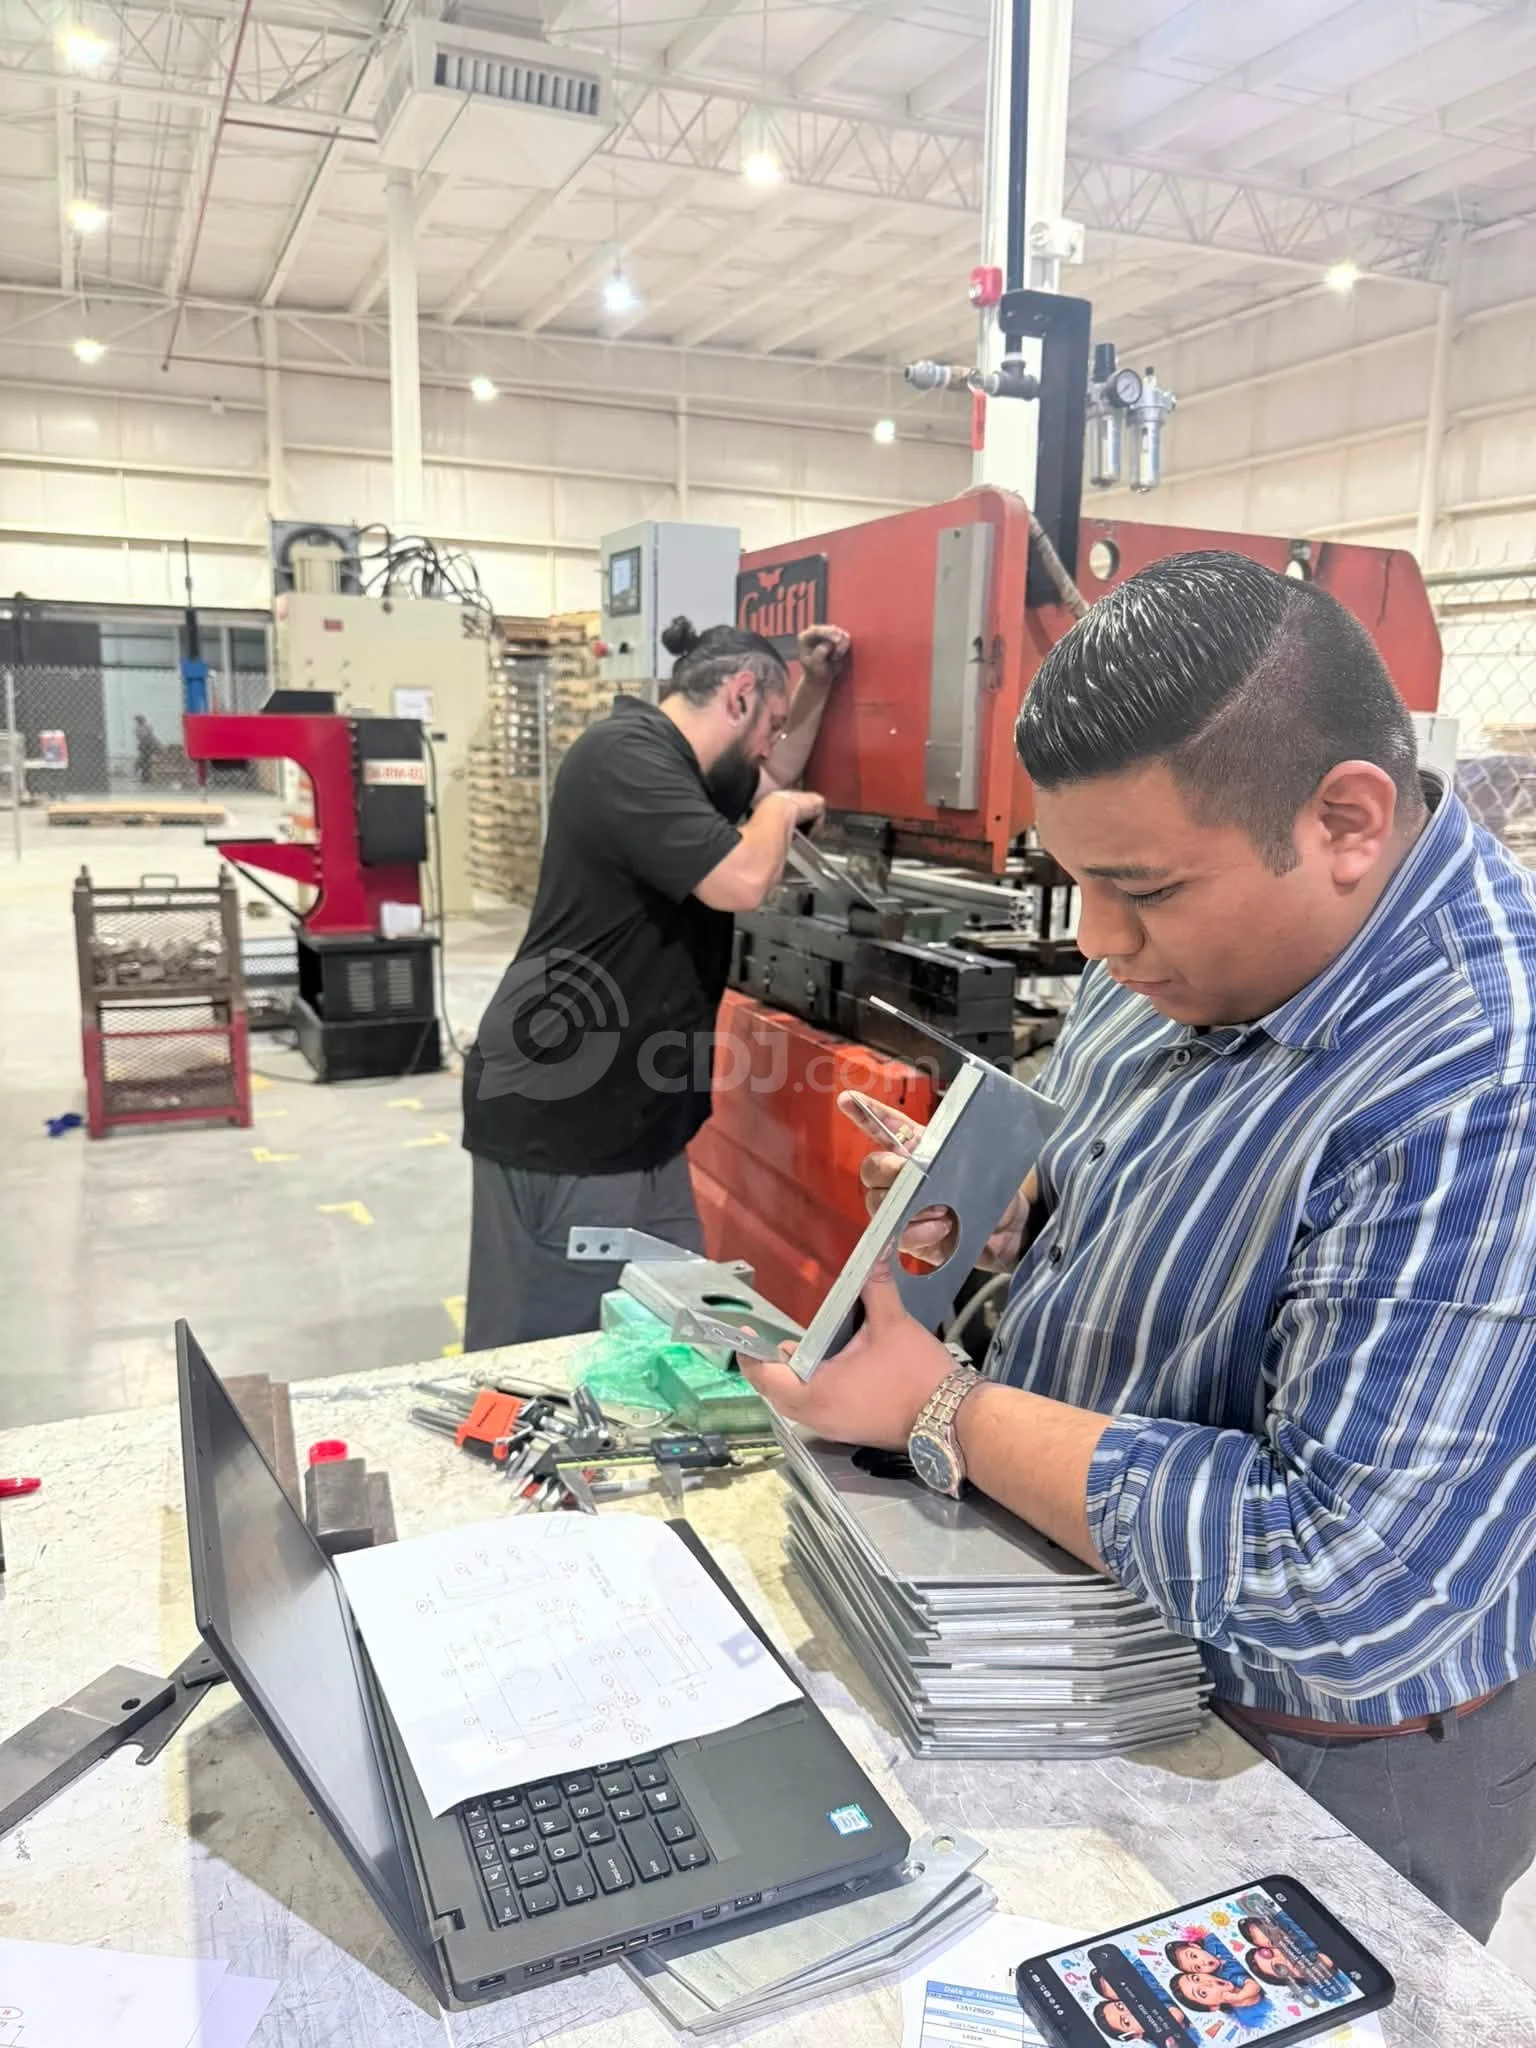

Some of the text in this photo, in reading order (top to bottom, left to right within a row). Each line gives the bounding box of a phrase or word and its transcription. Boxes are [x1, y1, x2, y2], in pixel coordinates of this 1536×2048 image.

[568, 1783, 579, 1792] D
[607, 1784, 620, 1793] X
[534, 1798, 546, 1807] E
[577, 1806, 589, 1816] S
[618, 1808, 630, 1818] Z
[514, 1817, 526, 1827] 3
[543, 1820, 555, 1831] W
[589, 1830, 601, 1839] A
[523, 1842, 535, 1851] 2
[553, 1846, 566, 1857] Q
[944, 1985, 963, 1996] Date
[976, 1991, 1016, 2001] Inspecti
